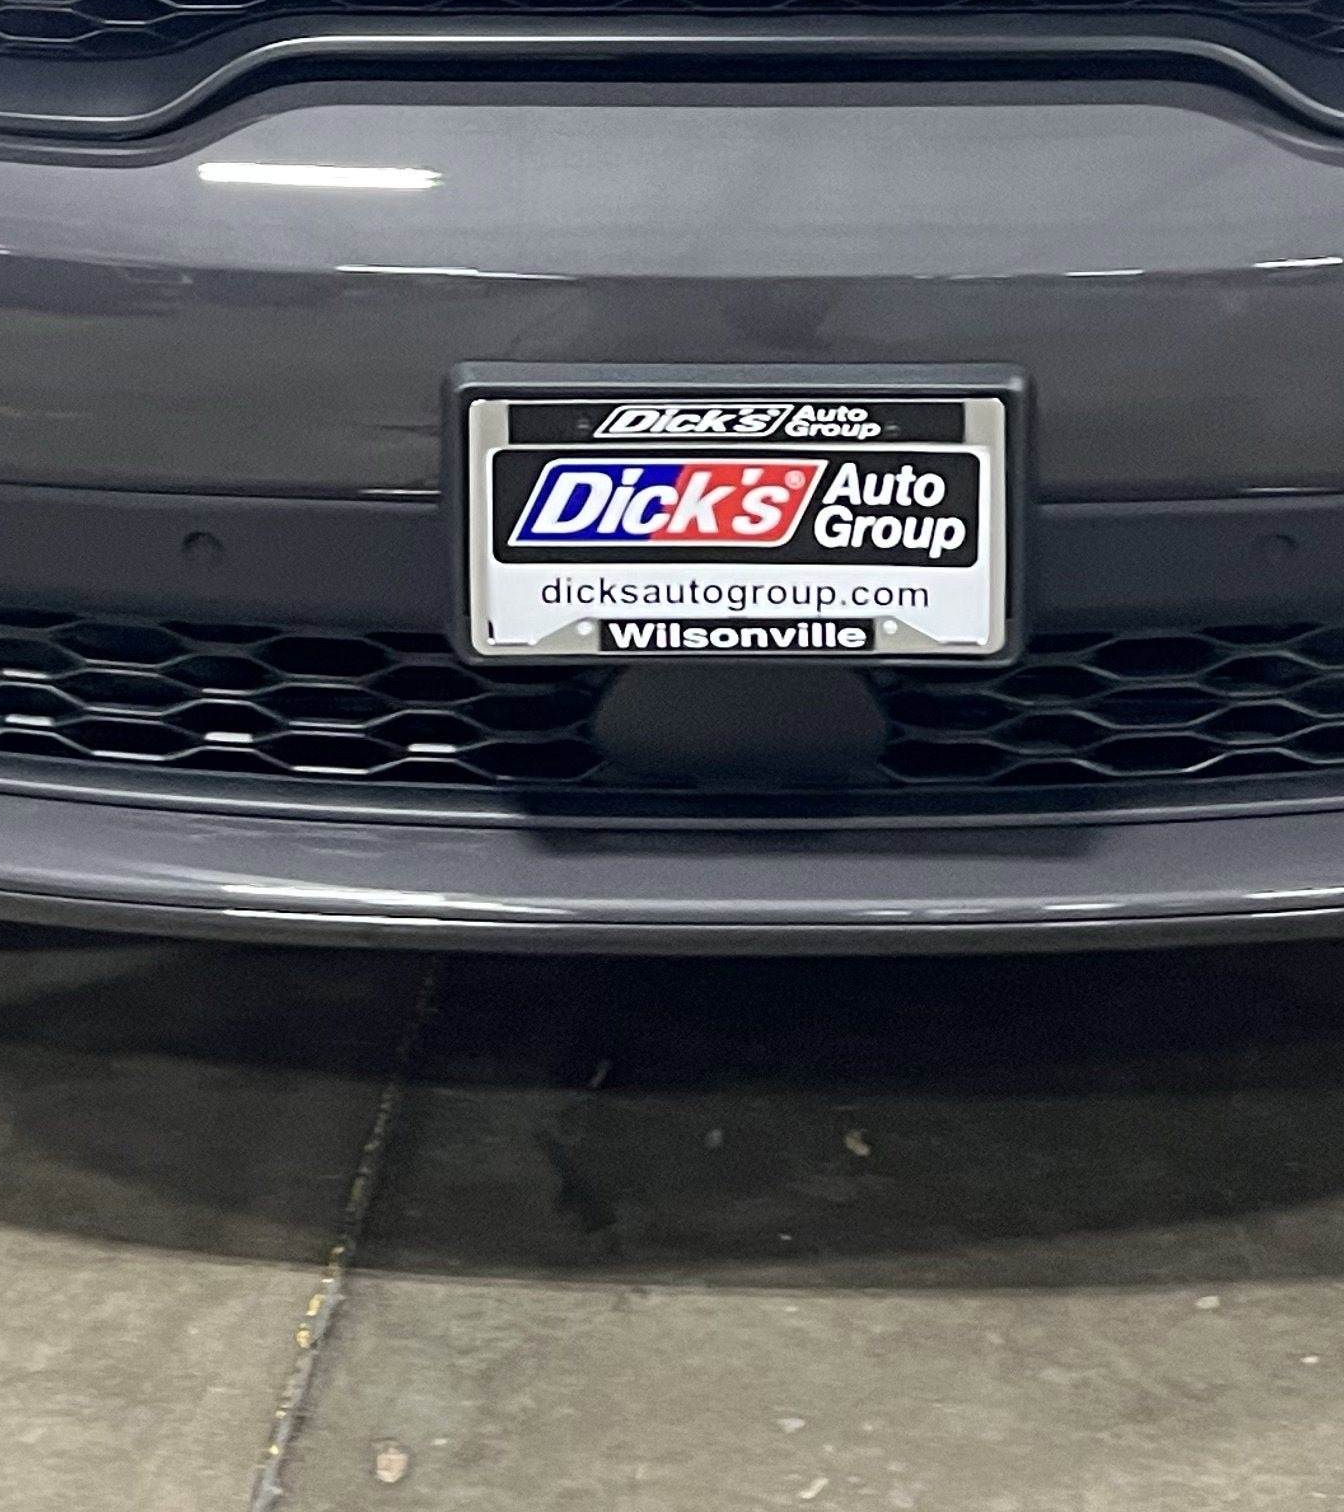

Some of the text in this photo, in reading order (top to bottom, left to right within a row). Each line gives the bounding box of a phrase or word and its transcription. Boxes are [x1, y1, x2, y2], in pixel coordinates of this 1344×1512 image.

[792, 405, 868, 422] Auto
[784, 420, 881, 440] Group
[822, 463, 945, 507] Auto
[814, 504, 966, 558] Group
[541, 577, 929, 612] dicksautogroup.com
[608, 622, 867, 649] Wilsonville
